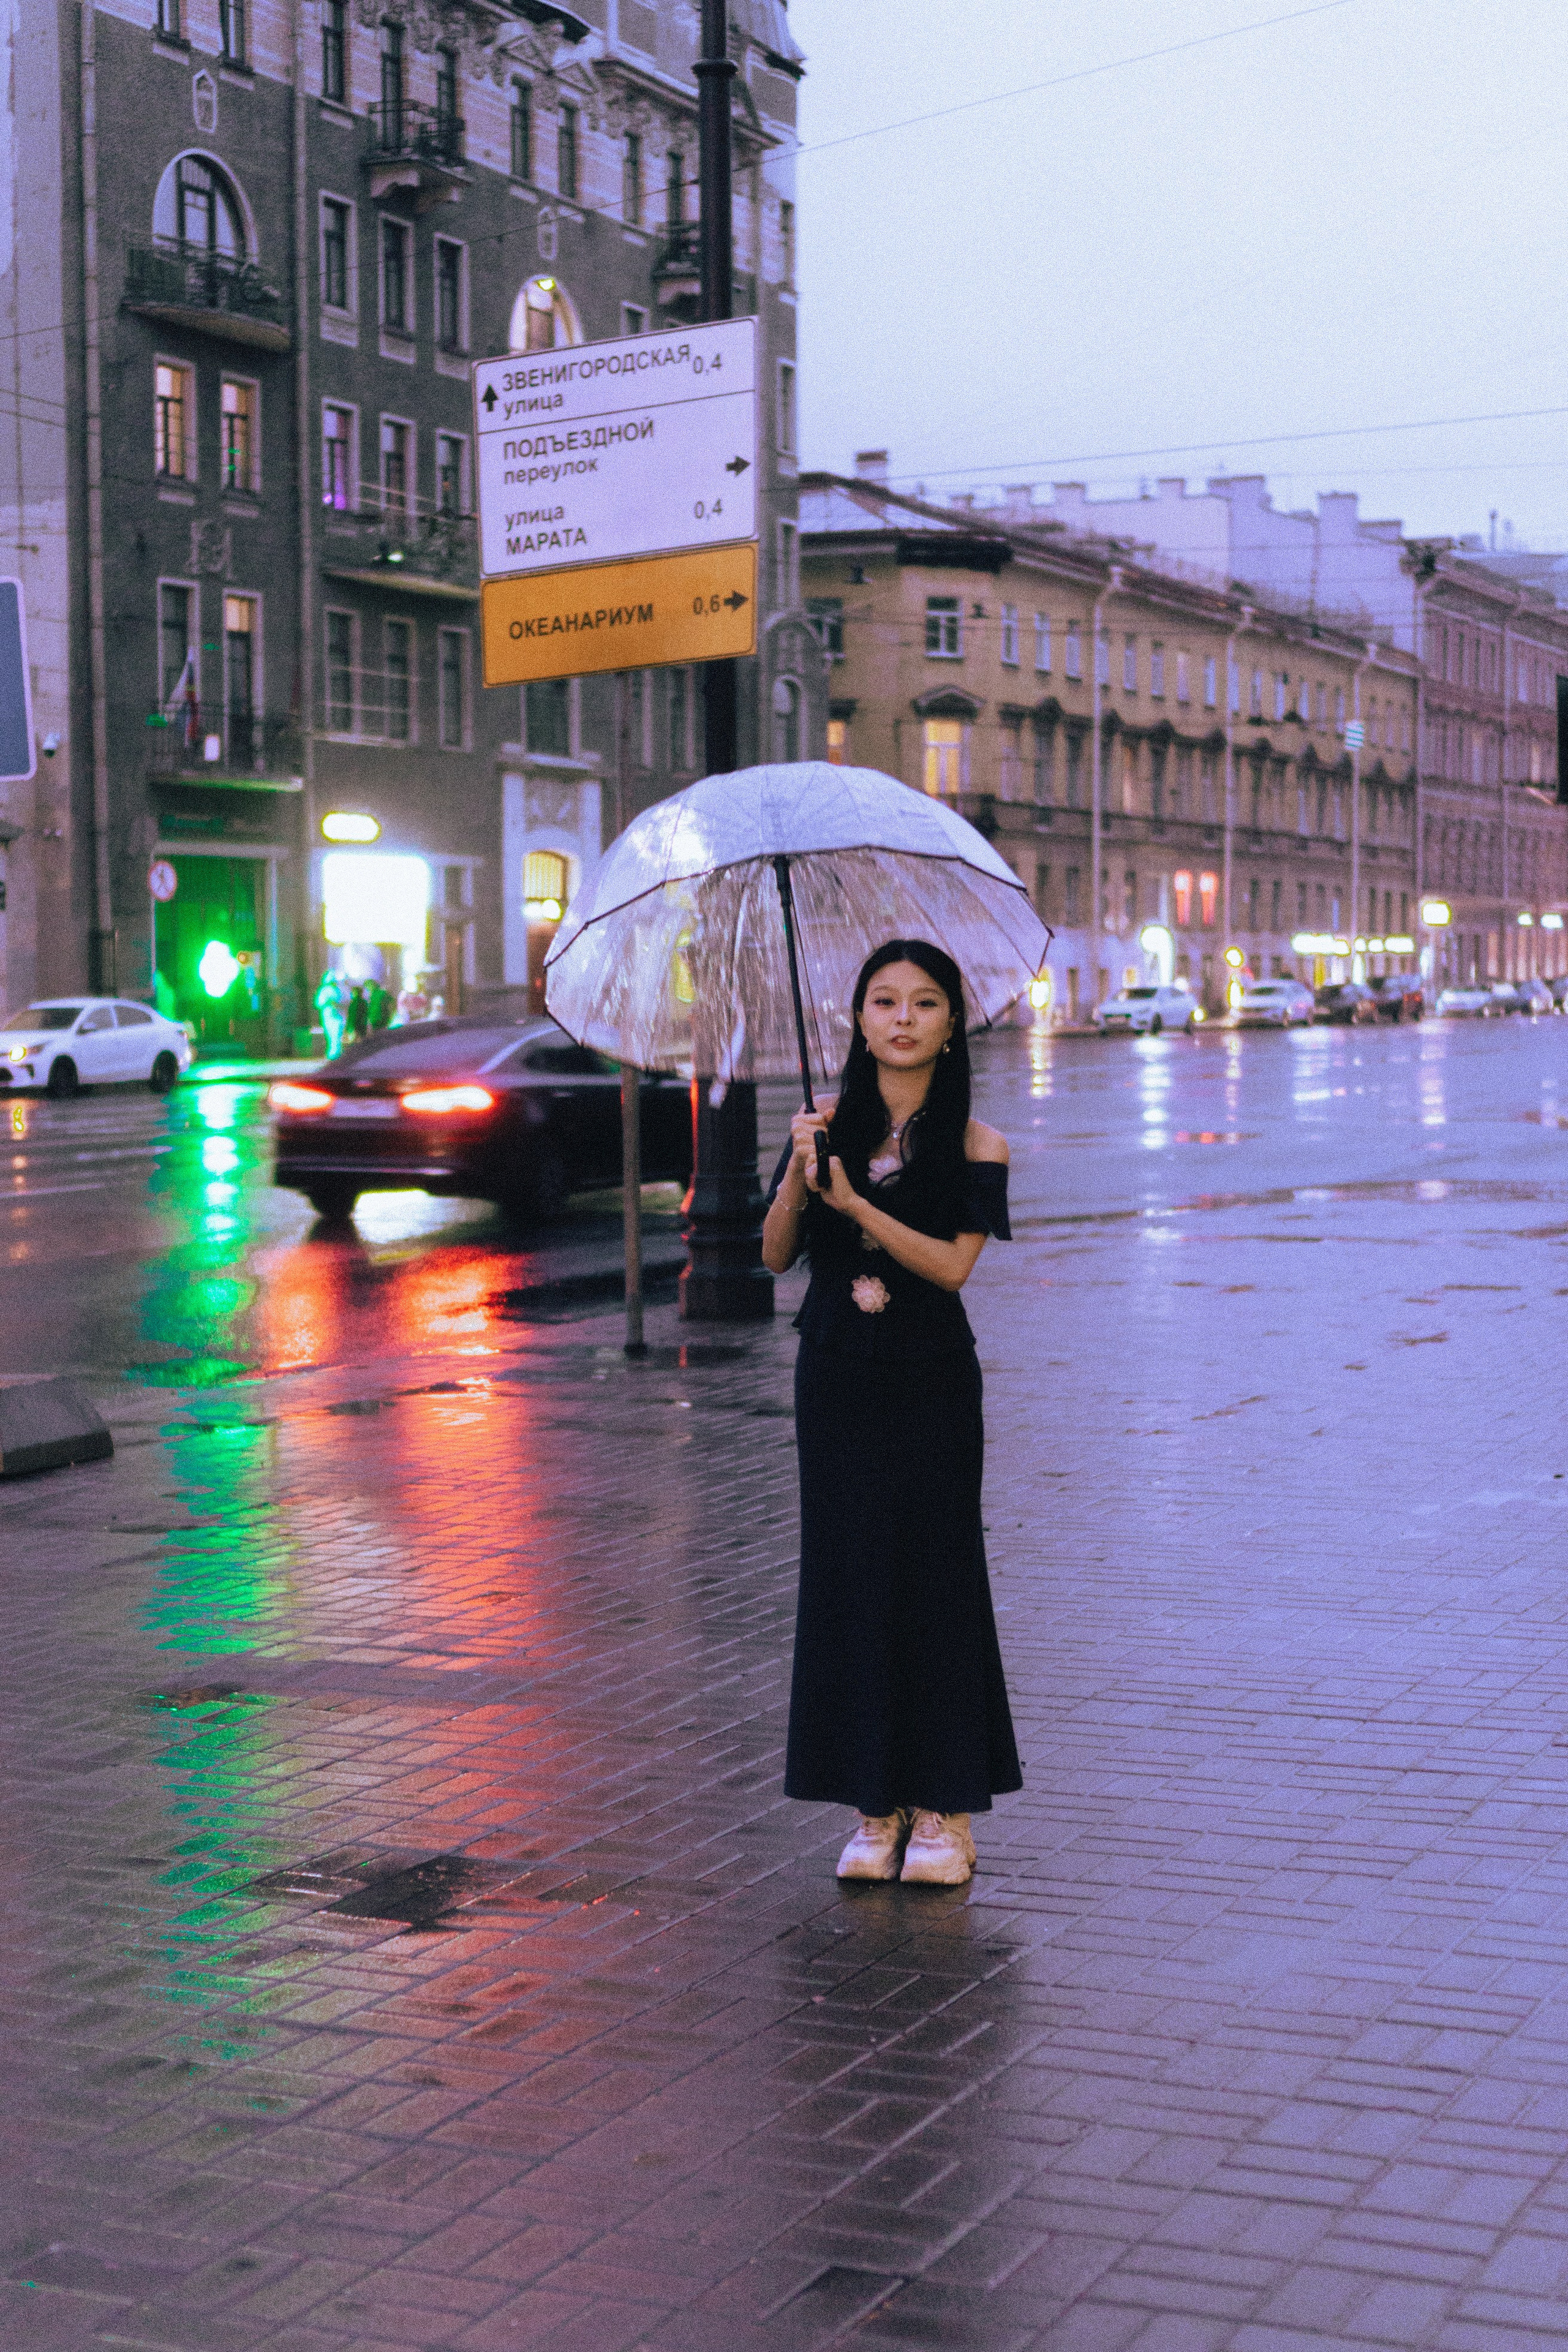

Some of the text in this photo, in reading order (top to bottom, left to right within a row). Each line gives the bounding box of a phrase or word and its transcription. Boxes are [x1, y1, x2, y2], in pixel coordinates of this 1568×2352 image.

[503, 344, 691, 392] ЗВЕНИГОРОДСКАЯ
[692, 353, 723, 375] 0,4
[503, 392, 564, 420] улица
[504, 417, 655, 460] ПОДЪЕЗДНОЙ
[503, 458, 598, 486] переулок
[505, 505, 565, 532] улица
[694, 498, 723, 521] 0,4
[506, 527, 588, 555] МАРАТА
[508, 594, 720, 640] ОКЕАНАРИУМ 0,6
